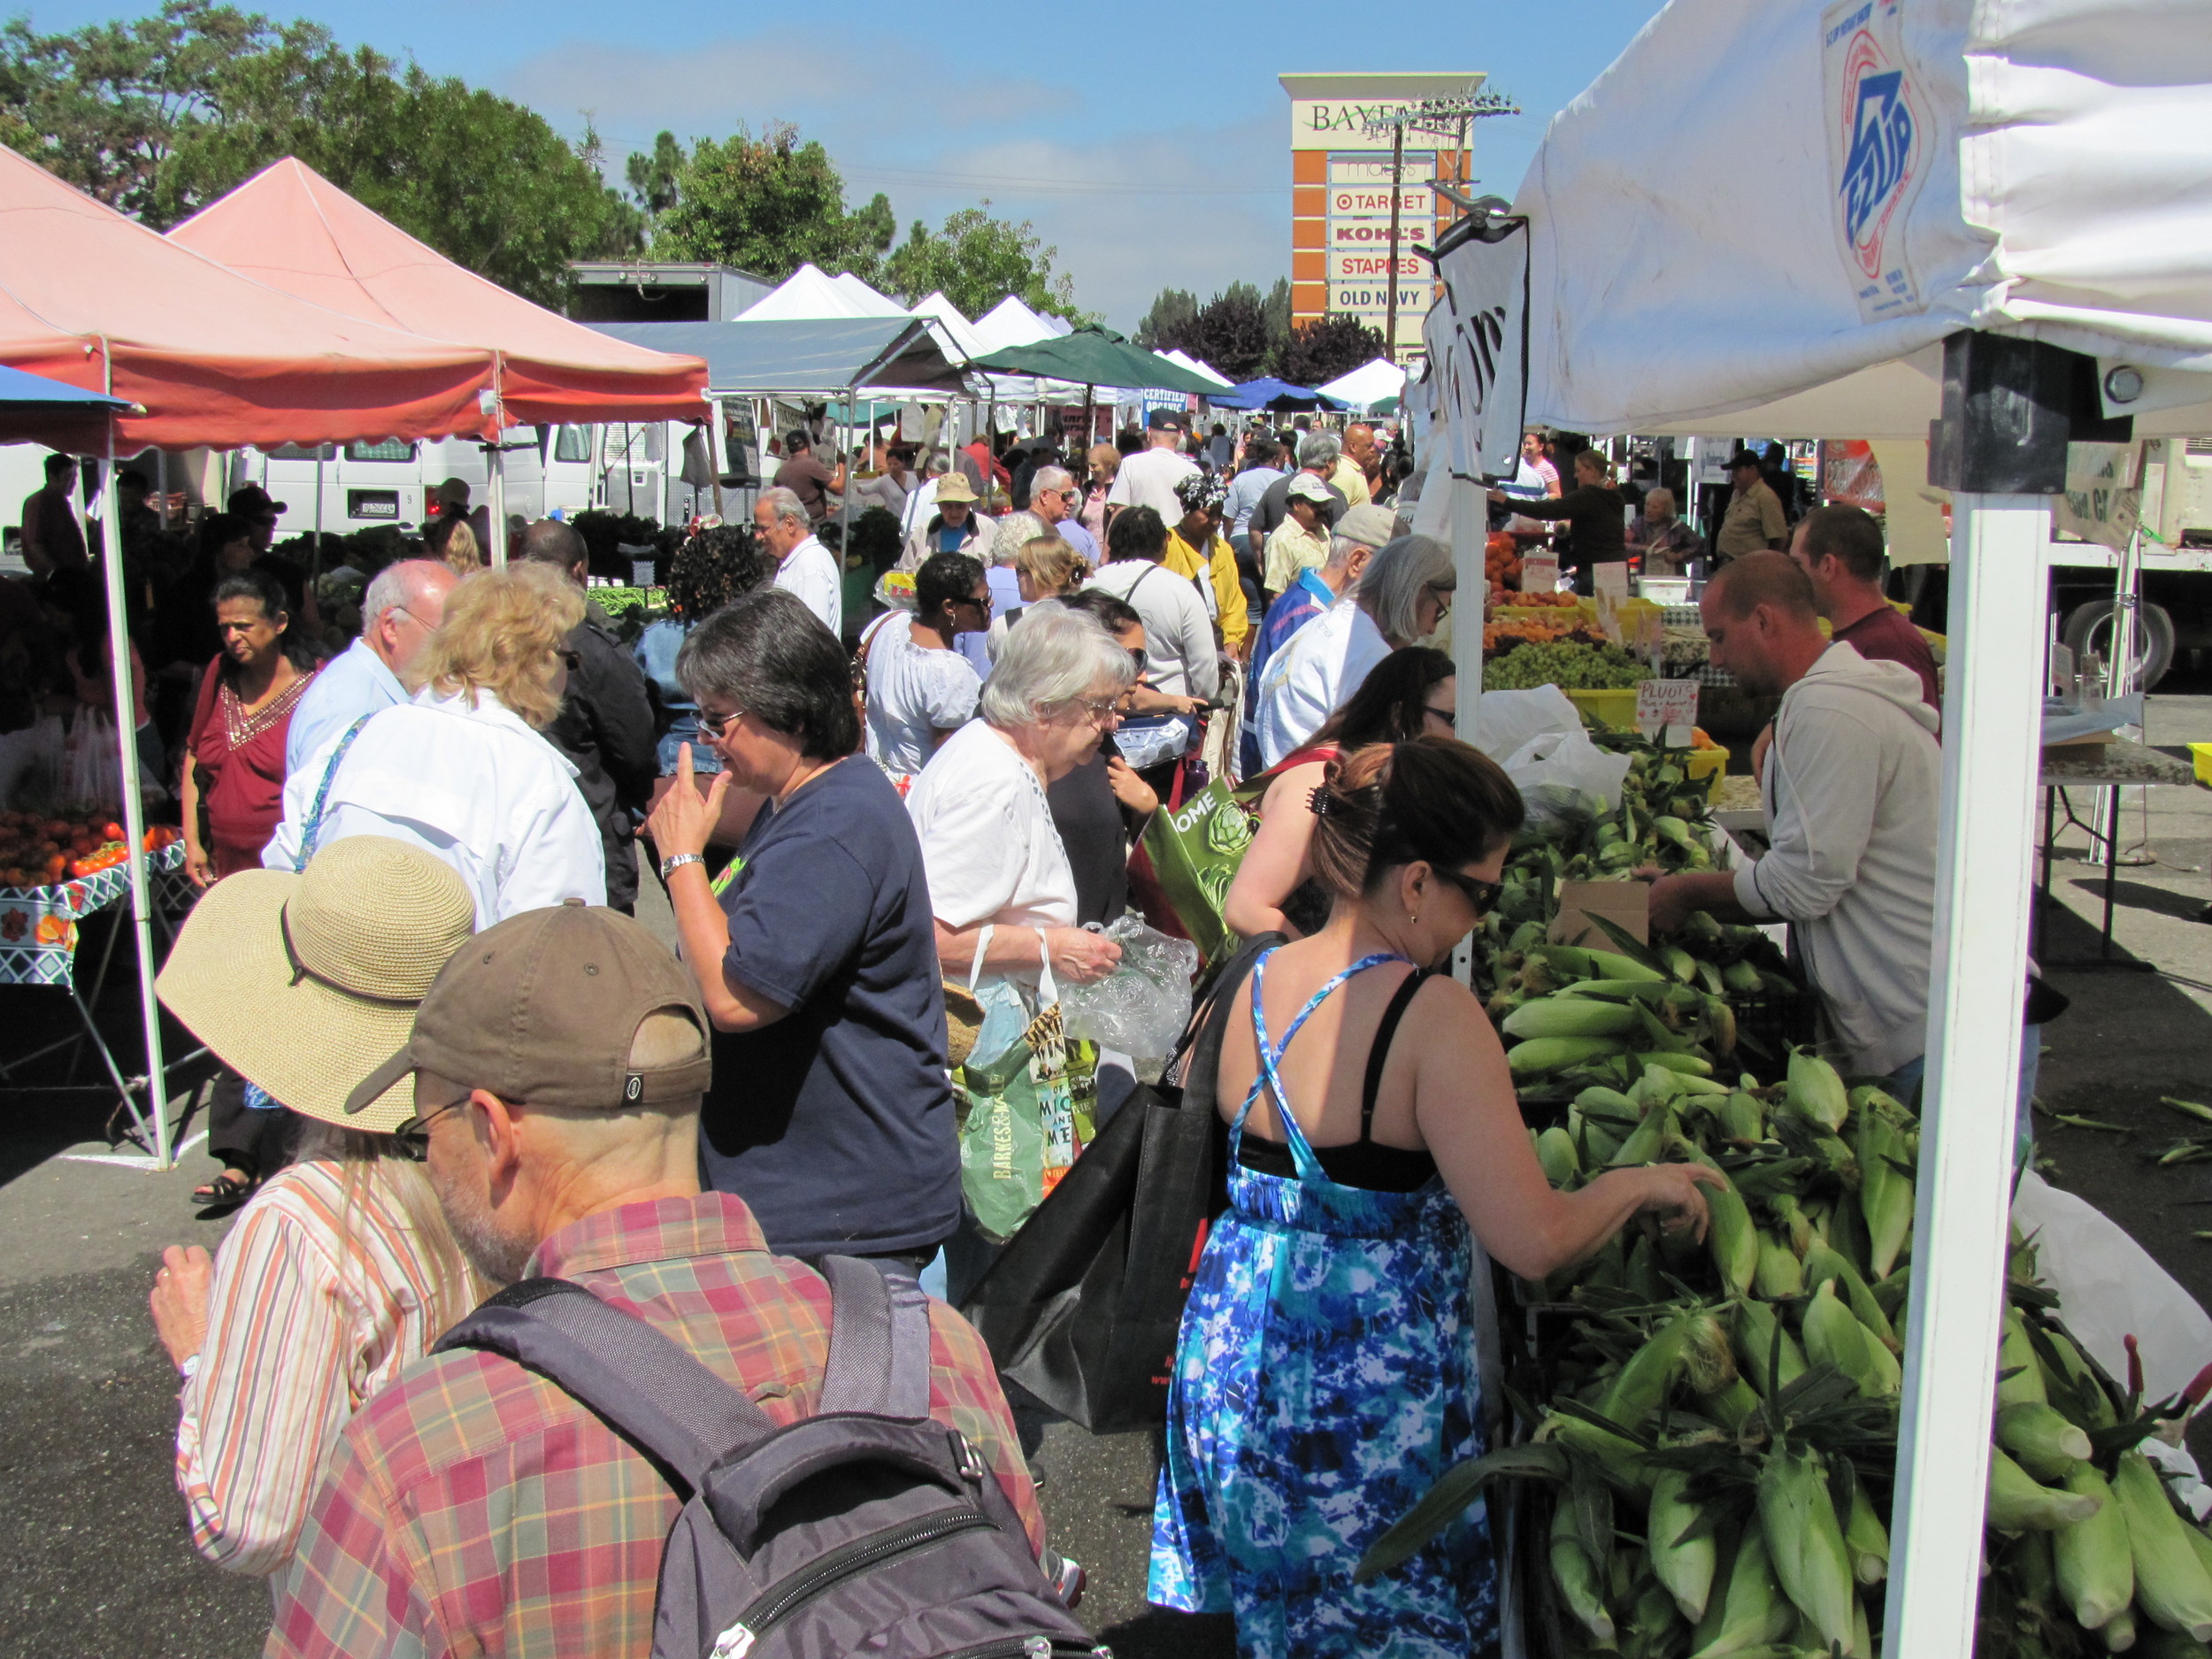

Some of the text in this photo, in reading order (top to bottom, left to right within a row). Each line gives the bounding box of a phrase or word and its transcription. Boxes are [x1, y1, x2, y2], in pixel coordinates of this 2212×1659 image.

[1340, 290, 1420, 305] OLD NVY
[1143, 388, 1186, 403] CERTIFIED
